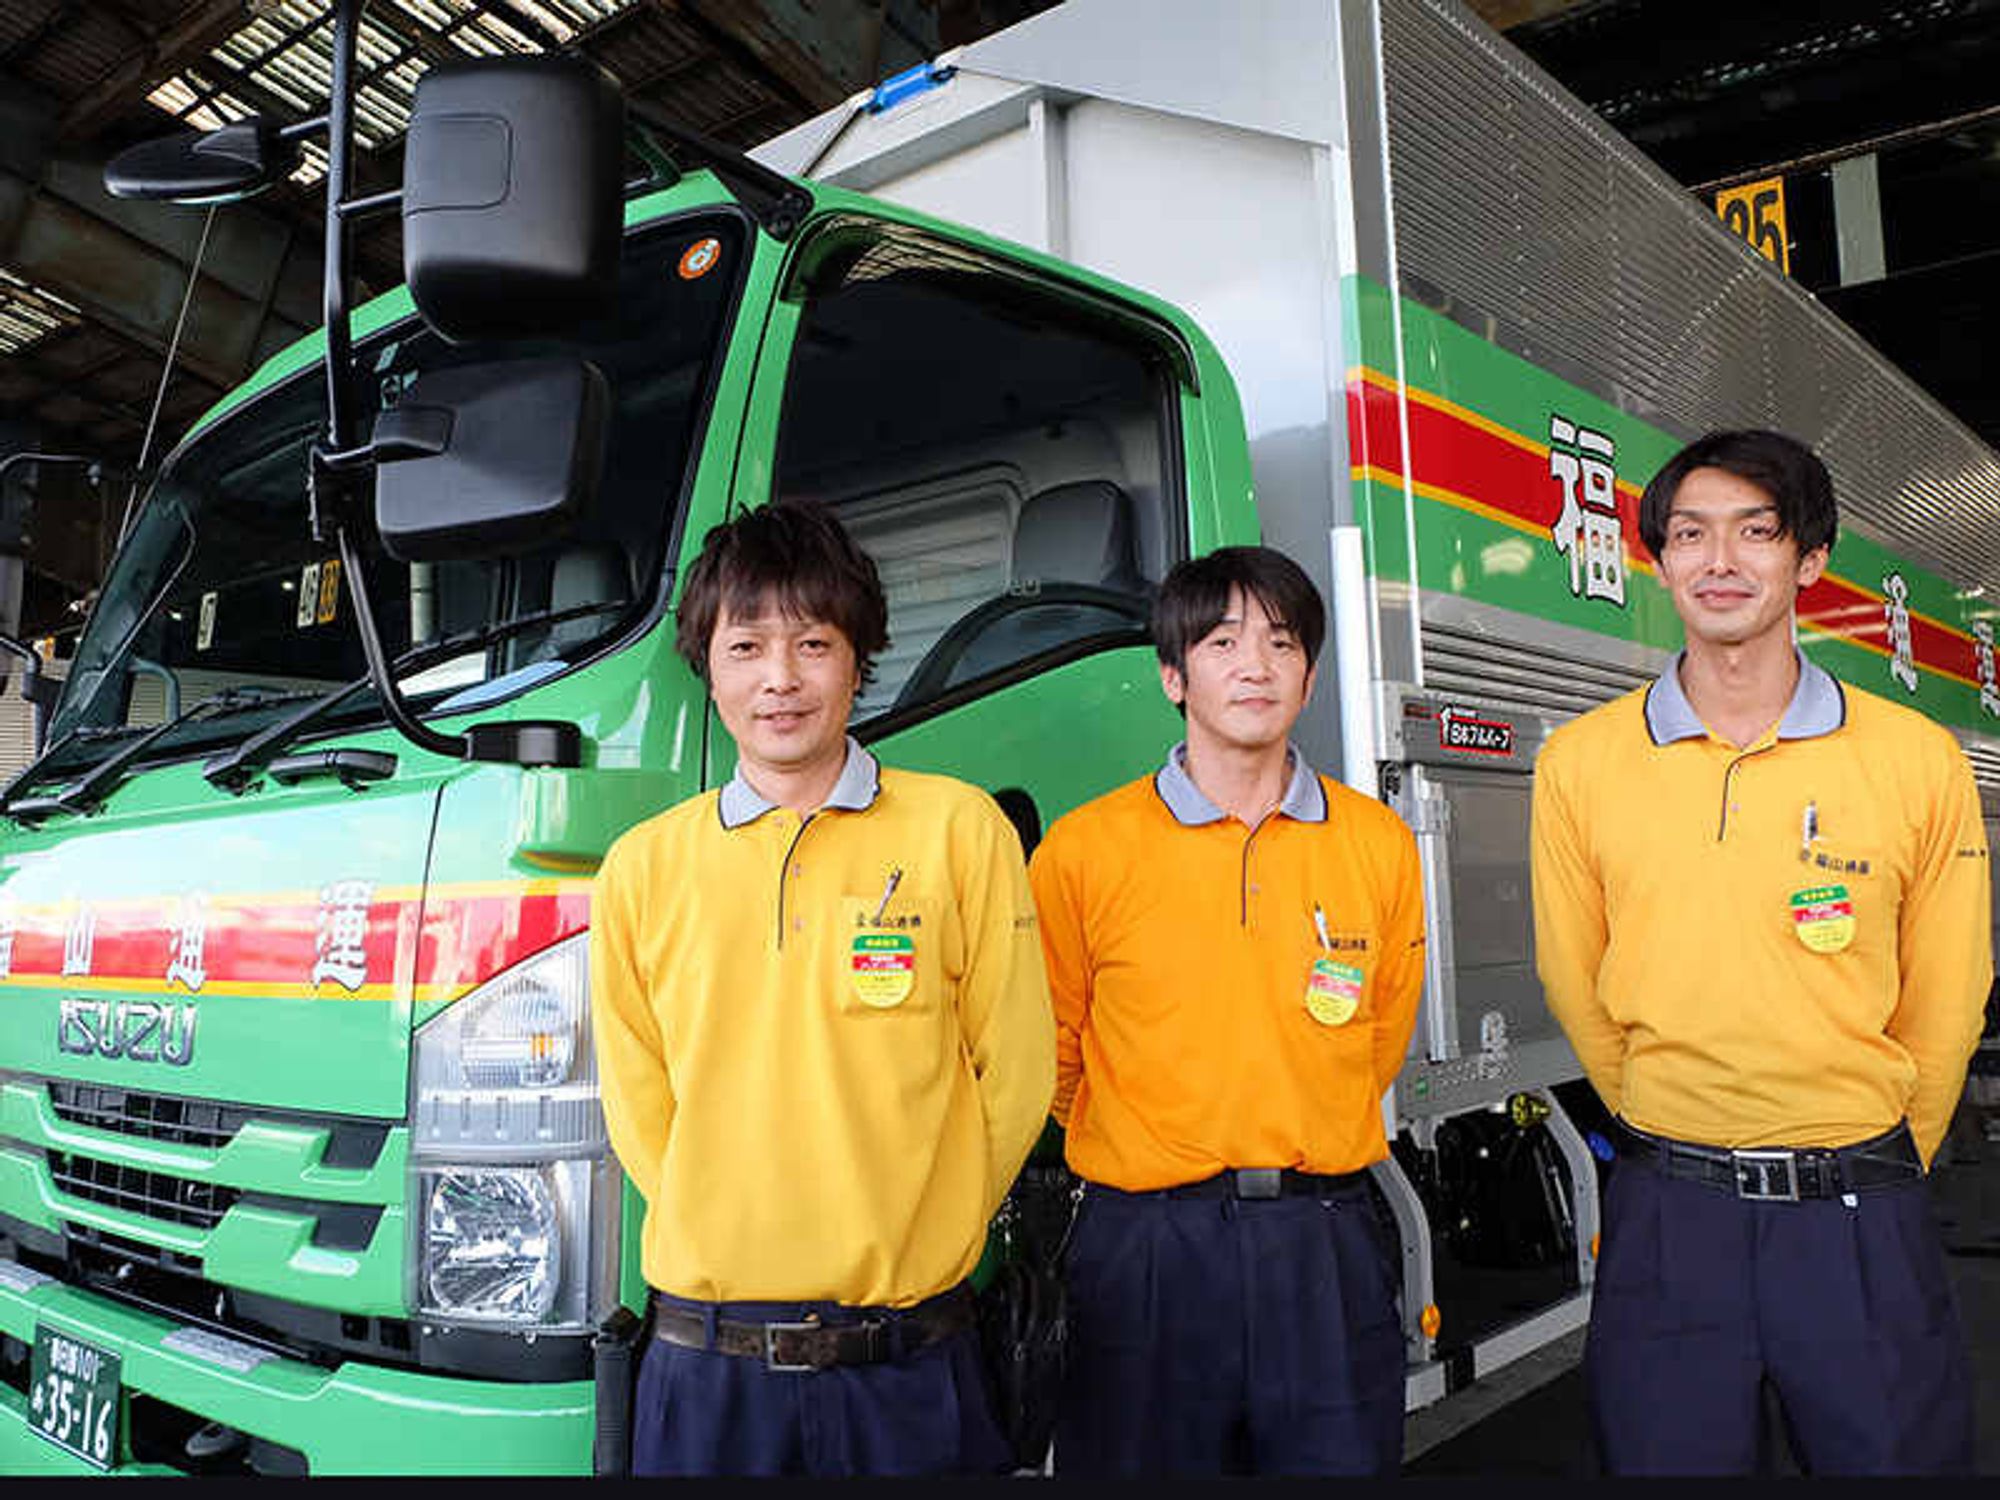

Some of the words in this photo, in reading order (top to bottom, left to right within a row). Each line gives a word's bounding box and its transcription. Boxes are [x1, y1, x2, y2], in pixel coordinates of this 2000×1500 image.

[1550, 414, 1625, 609] 福
[59, 998, 197, 1066] ISUZU
[42, 1372, 112, 1460] 35-16
